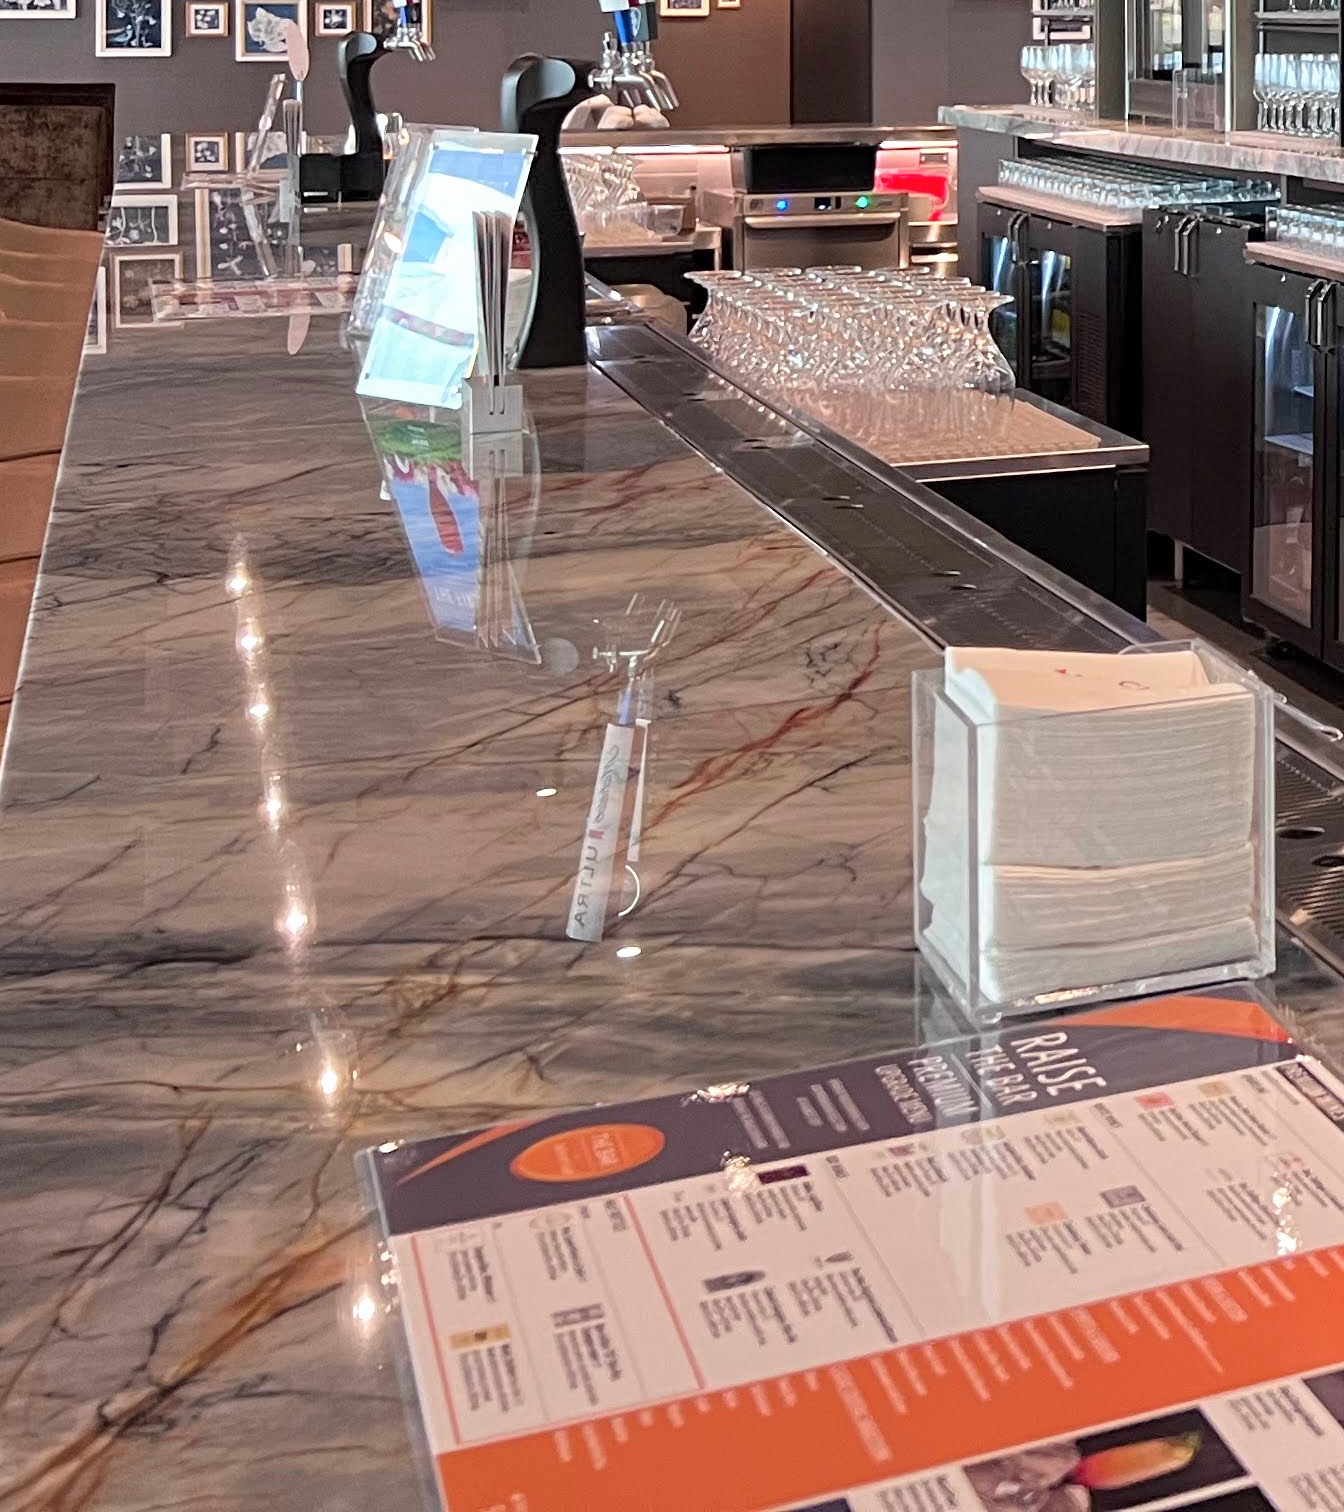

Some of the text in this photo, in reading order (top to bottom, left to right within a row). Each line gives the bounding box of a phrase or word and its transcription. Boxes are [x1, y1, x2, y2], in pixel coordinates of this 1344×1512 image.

[907, 1055, 980, 1117] PREMIUM
[965, 1044, 1038, 1107] THE BAR
[1010, 1031, 1107, 1097] RAISE
